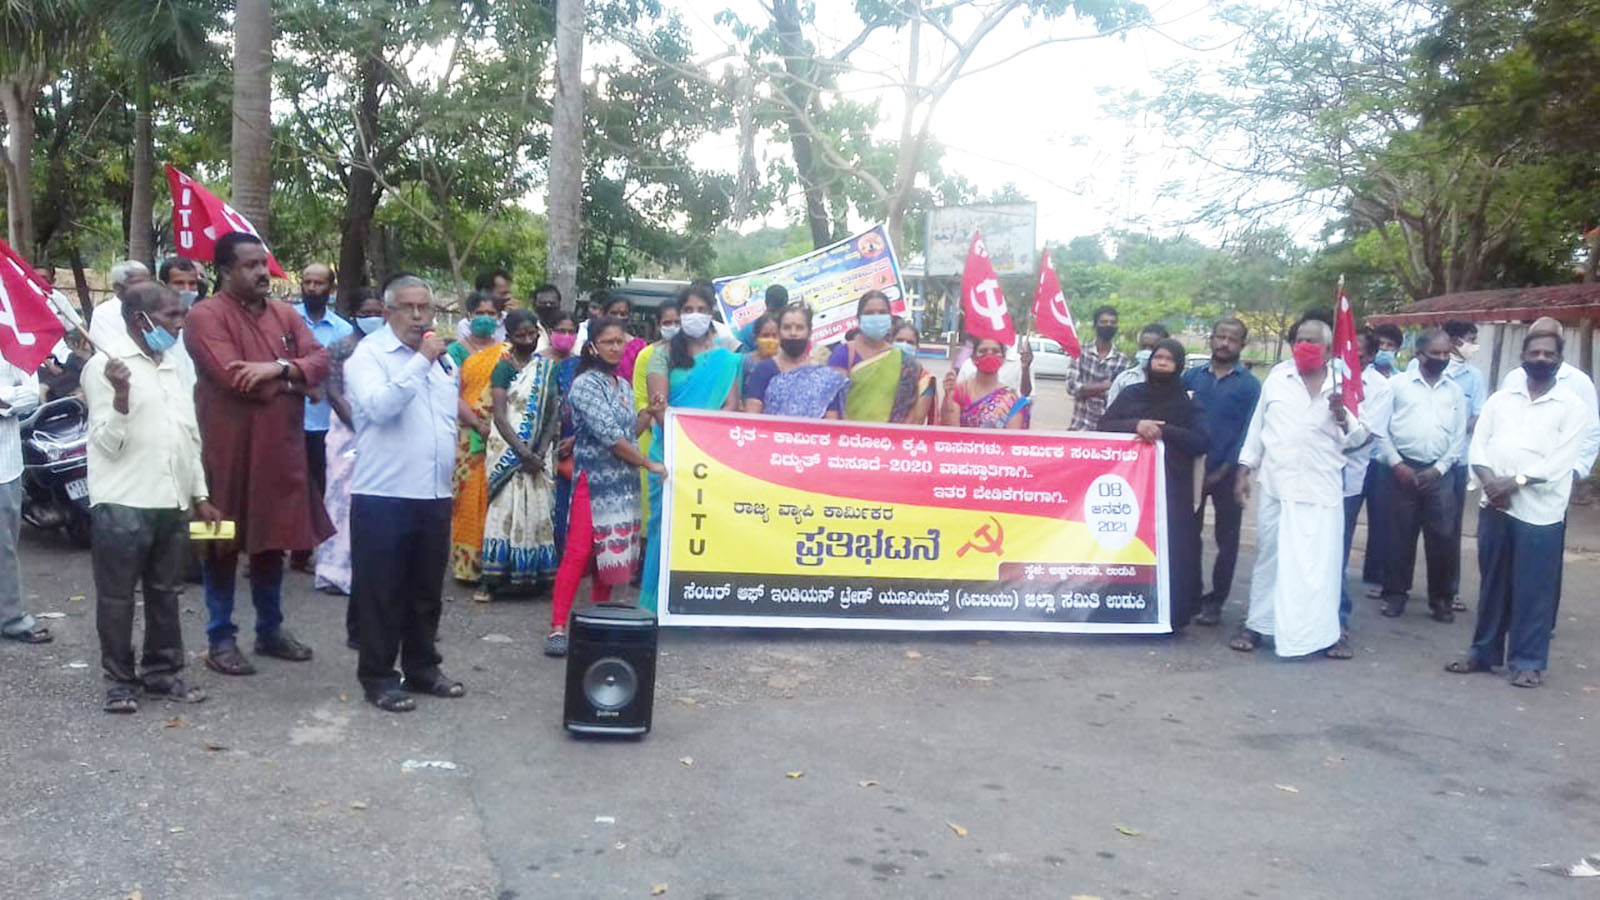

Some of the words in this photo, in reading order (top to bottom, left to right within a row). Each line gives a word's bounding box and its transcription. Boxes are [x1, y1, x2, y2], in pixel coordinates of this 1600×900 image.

[773, 431, 831, 446] ಕಾರ್ಮಿಕ
[1011, 444, 1065, 459] ಕಾರ್ಮಿಕ
[933, 485, 967, 500] ಇತರ
[1098, 482, 1122, 498] 08
[733, 501, 770, 523] ರಾಜ್ಯ
[823, 505, 894, 520] ಕಾರ್ಮಿಕರ
[1091, 503, 1132, 515] ಜನವರಿ
[1098, 521, 1128, 533] 2021
[795, 526, 941, 566] ಪ್ರತಿಭಟನೆ
[683, 582, 731, 601] ಸೆಂಟರ್
[771, 586, 834, 604] ಇಂಡಿಯನ್
[840, 587, 873, 609] ಟ್ರೇಡ್
[1024, 591, 1055, 613] ಜಿಲ್ಲಾ
[1061, 592, 1101, 608] ಸಮಿತಿ
[1106, 595, 1146, 609] ಉಡುಪಿ
